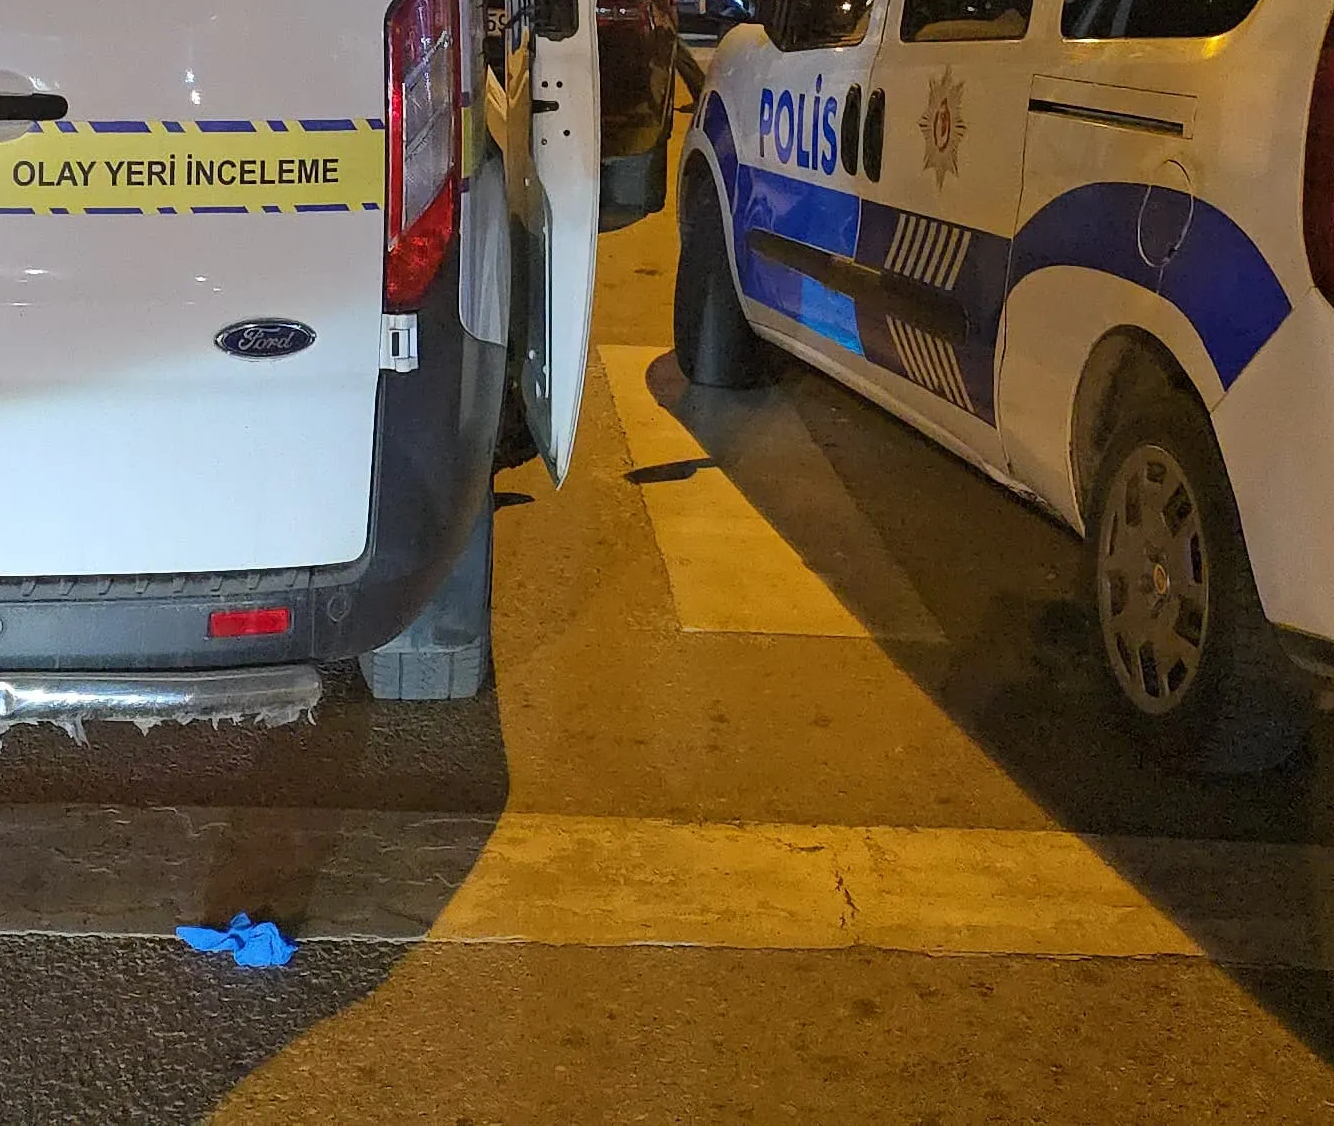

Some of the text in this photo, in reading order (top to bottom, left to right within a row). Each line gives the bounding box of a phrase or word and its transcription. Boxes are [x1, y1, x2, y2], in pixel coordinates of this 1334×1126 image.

[13, 153, 340, 187] OLAY YERİ İNCELEME
[236, 325, 296, 355] Ford
